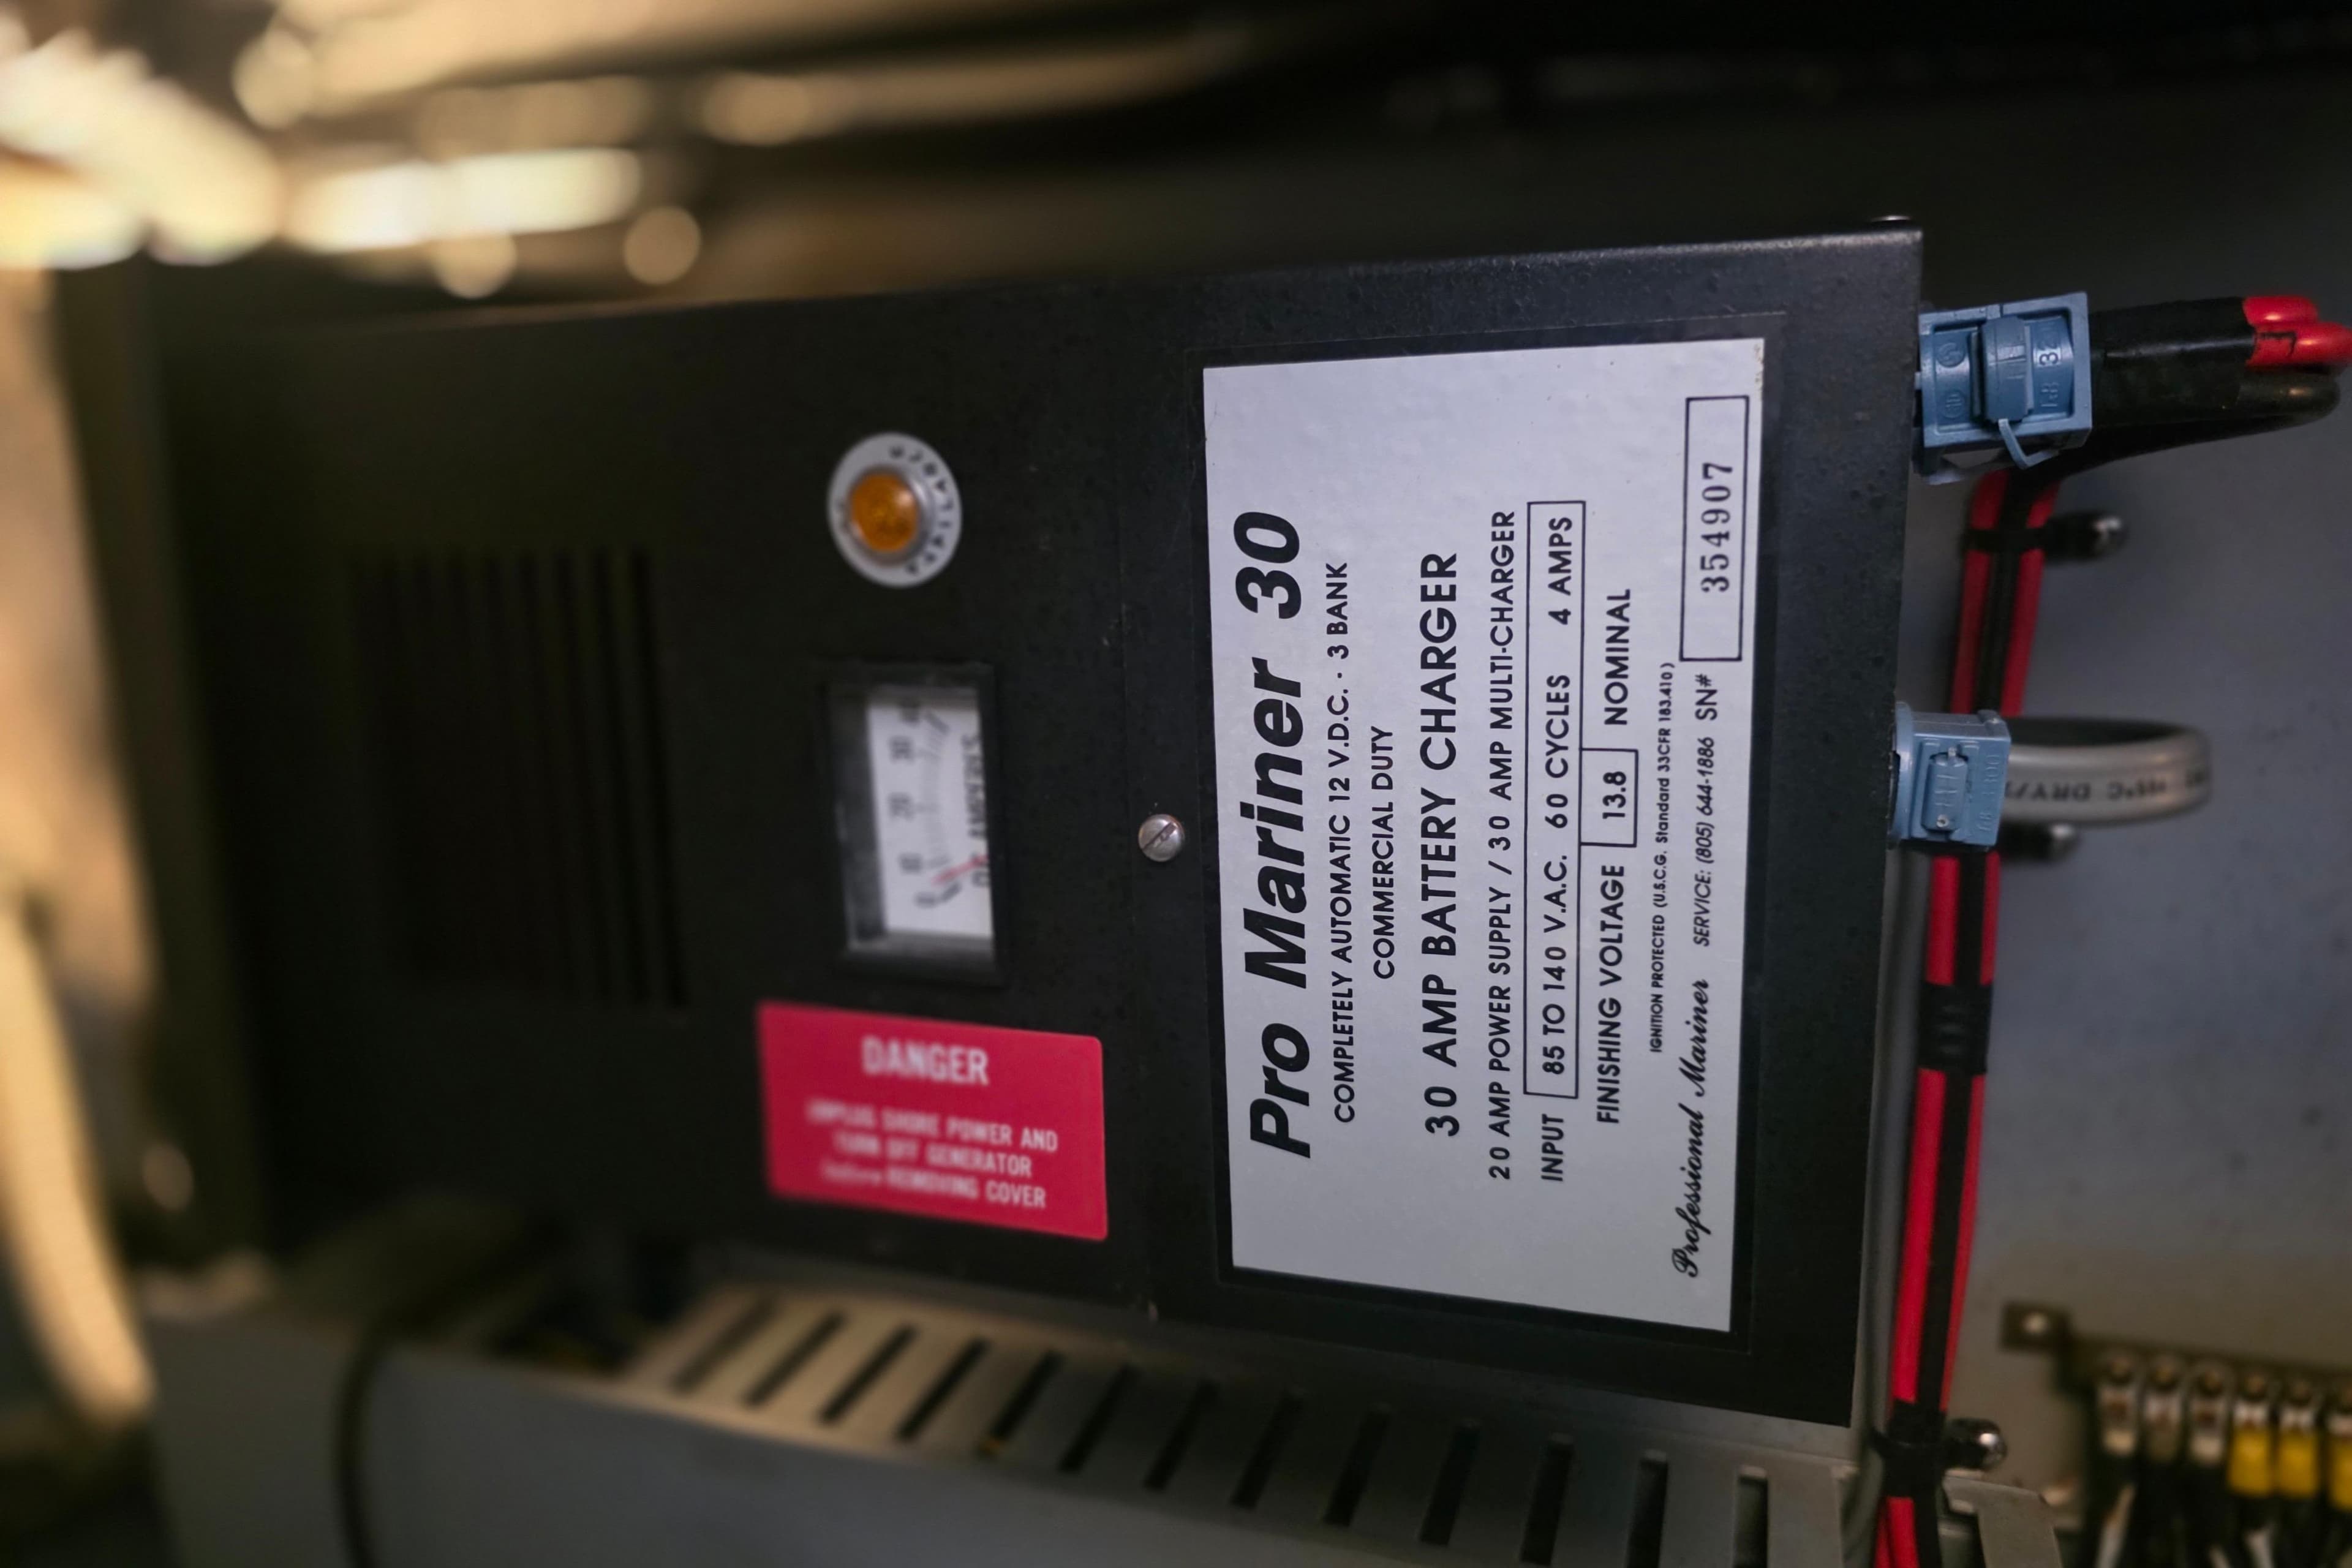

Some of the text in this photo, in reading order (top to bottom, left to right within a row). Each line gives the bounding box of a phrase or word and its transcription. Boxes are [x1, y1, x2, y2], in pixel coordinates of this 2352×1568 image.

[1325, 562, 1348, 635] BANK
[1327, 644, 1349, 660] 3
[1327, 688, 1350, 768] V.D.C.
[1657, 728, 1671, 772] 33CFR
[888, 793, 914, 822] 20
[1328, 777, 1351, 802] 12
[1655, 777, 1670, 843] Standard
[1233, 511, 1311, 1159] Pro Mariner 30
[1370, 725, 1395, 979] COMMERCIAL DUTY
[1419, 553, 1460, 1137] 30 AMP BATTERY CHARGER
[1488, 511, 1515, 1180] 20 AMP POWER SUPPLY / 30 AMP MULTI-CHARGER
[1540, 517, 1573, 1182] INPUT 85 TO 140 V.A.C. 60 CYCLES 4 AMPS
[1596, 589, 1631, 1124] FINISHING VOLTAGE 13.8 NOMINAL
[1672, 462, 1733, 1278] Professional Mariner SERVICE: (805) 644-1886 SN# 354907
[1328, 814, 1353, 963] AUTOMATIC
[1653, 851, 1668, 908] (U.S.C.G.
[1651, 914, 1665, 989] PROTECTED
[1331, 971, 1355, 1123] COMPLETELY
[1649, 993, 1664, 1053] IGNITION
[861, 1035, 989, 1086] DANGER
[833, 1131, 1033, 1177] TURN OFF GENERATOR
[881, 1107, 941, 1137] SHORE
[947, 1116, 1012, 1146] POWER
[1020, 1127, 1058, 1153] AND
[885, 1166, 979, 1200] REMOVING
[985, 1180, 1046, 1209] COVER
